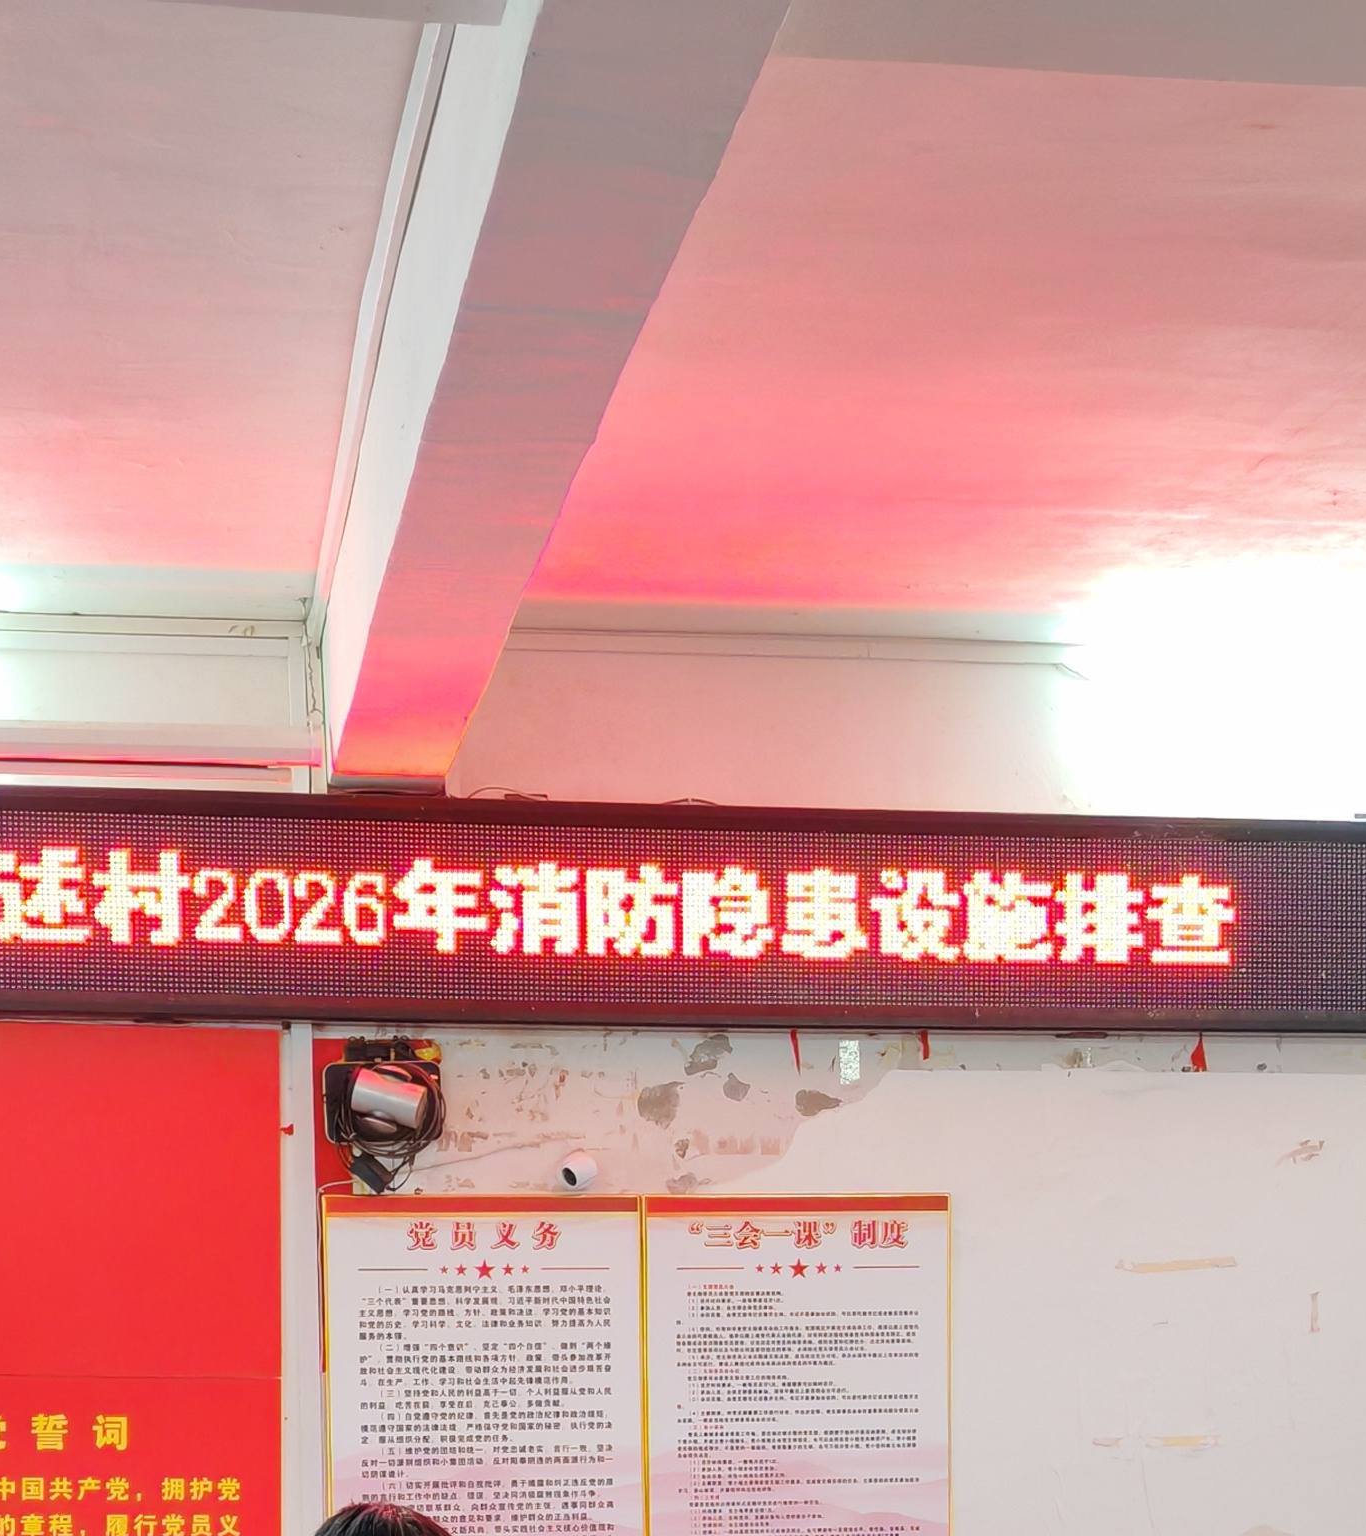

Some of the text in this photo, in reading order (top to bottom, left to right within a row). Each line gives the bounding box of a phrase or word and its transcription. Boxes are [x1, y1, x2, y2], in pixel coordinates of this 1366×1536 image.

[406, 1222, 562, 1251] 党员义务
[688, 1219, 909, 1249] “三会一课”制度
